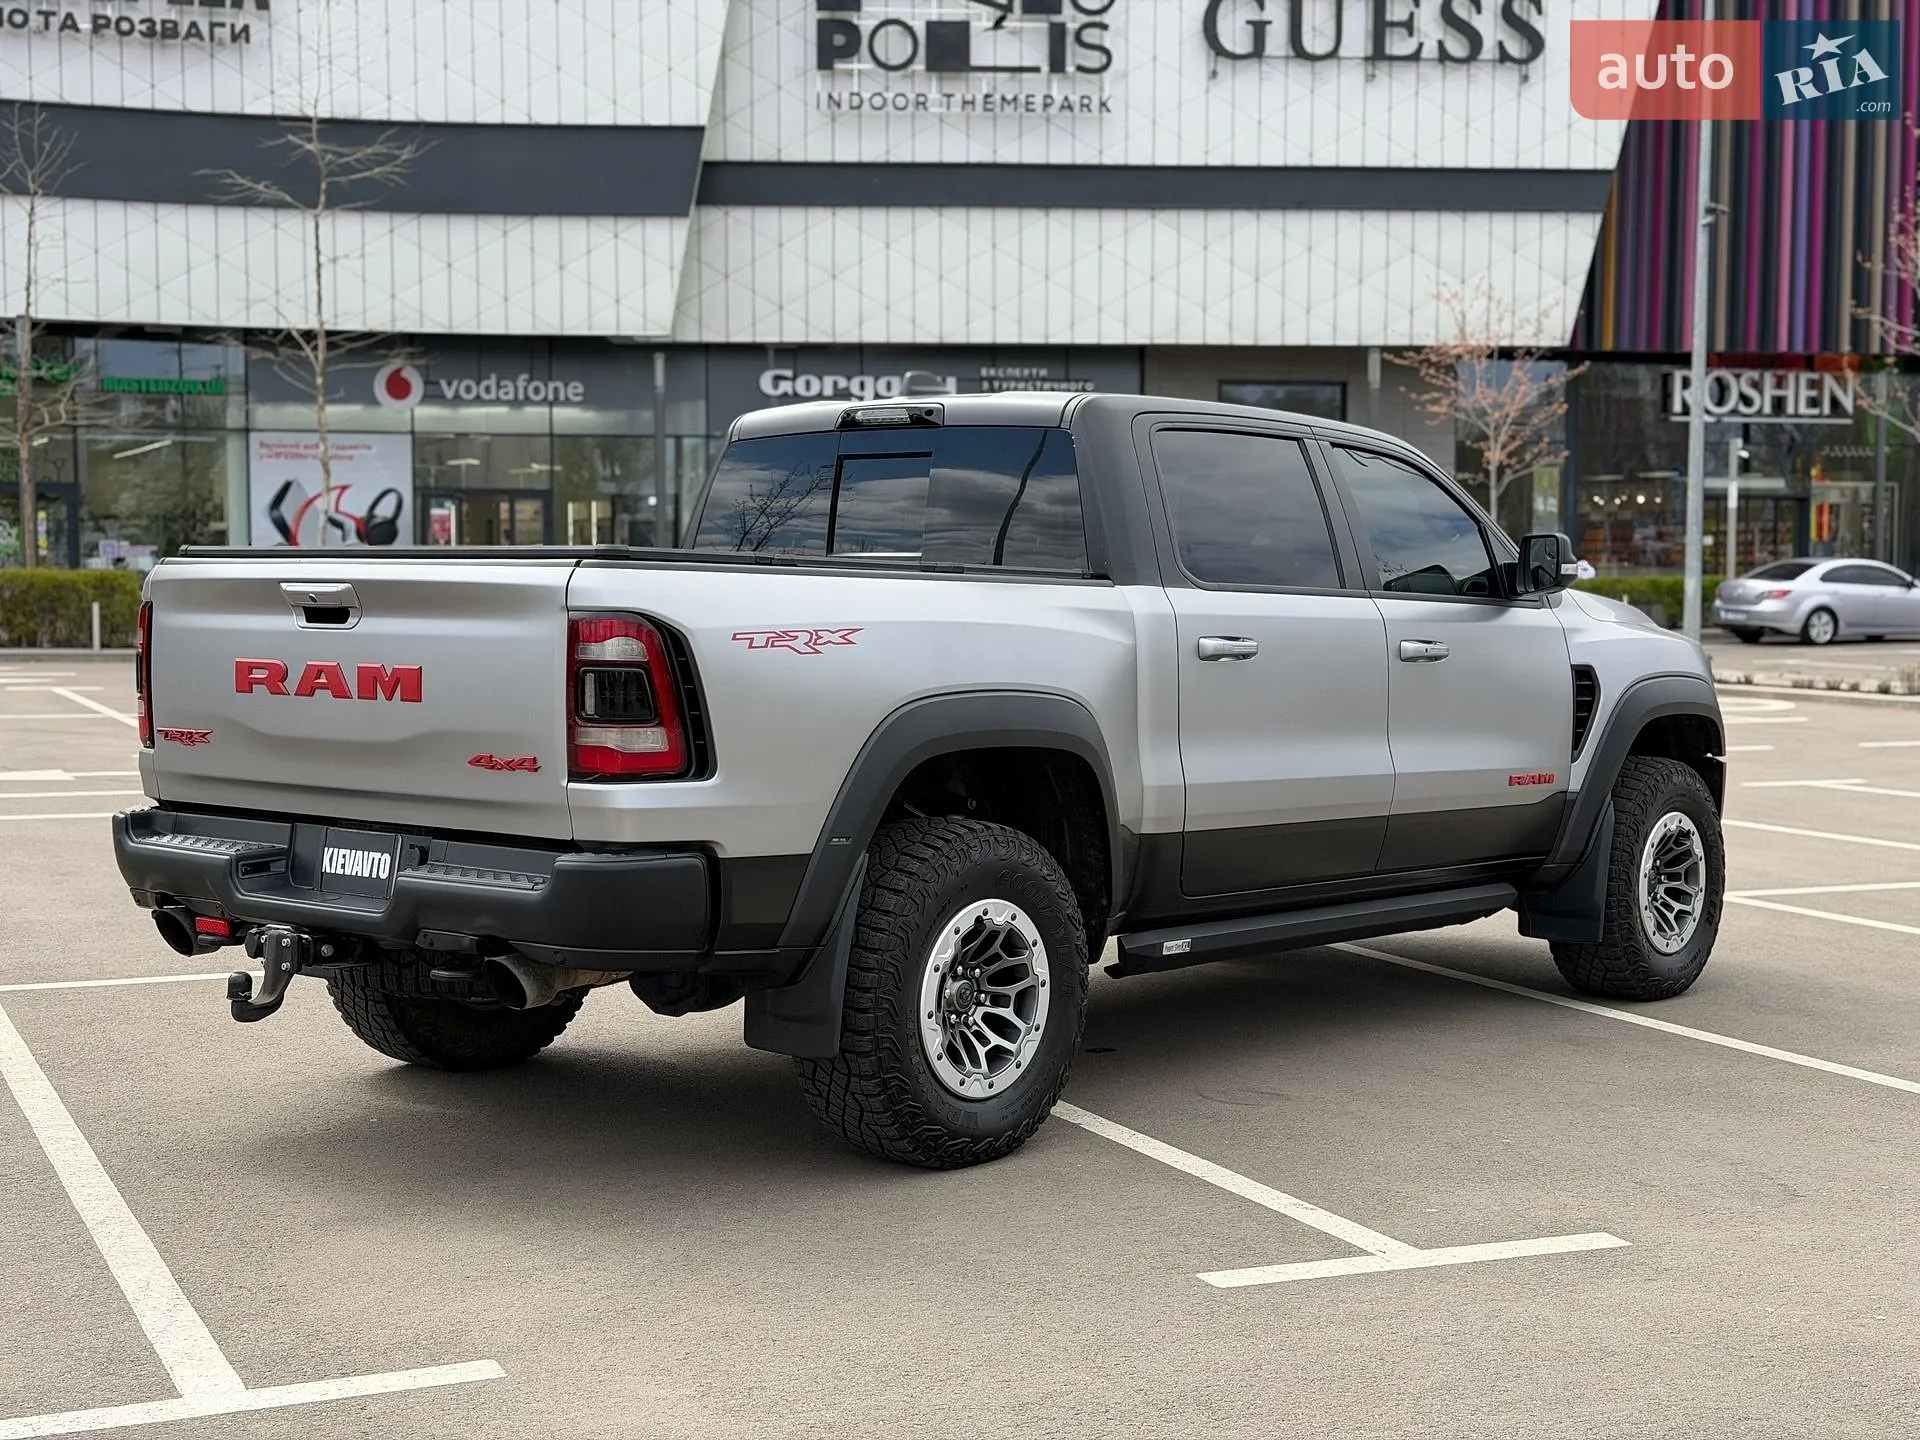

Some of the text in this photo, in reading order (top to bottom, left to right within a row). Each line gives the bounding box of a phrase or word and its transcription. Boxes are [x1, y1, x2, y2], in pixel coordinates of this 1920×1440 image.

[37, 10, 81, 33] ТА
[91, 14, 250, 44] РОЗВАГИ
[1203, 0, 1545, 64] GUESS
[816, 92, 929, 112] INDOOR
[440, 373, 584, 402] vodafone
[731, 627, 864, 656] TRX
[234, 657, 423, 703] RAM
[157, 727, 213, 746] TRX
[1508, 773, 1555, 786] RAM
[321, 846, 392, 880] KIEVAVTO
